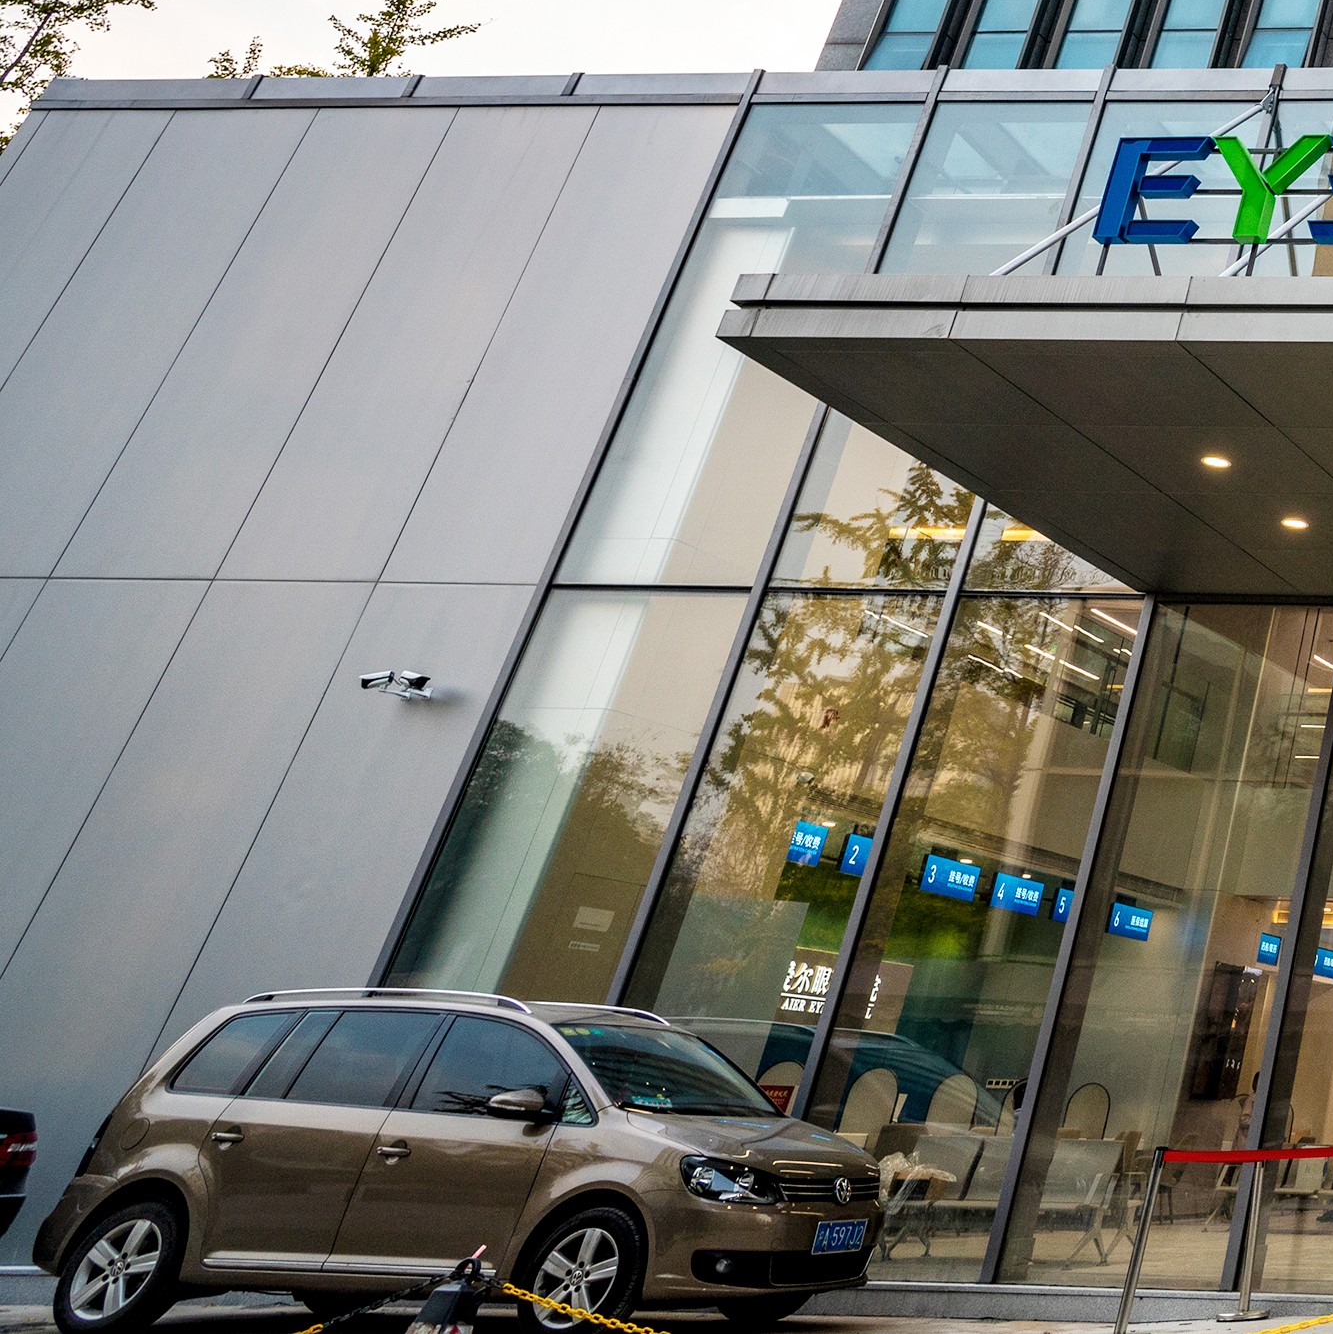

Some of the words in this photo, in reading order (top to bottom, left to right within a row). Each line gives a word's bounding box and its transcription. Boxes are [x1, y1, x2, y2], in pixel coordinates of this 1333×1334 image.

[848, 844, 860, 865] 2
[927, 864, 937, 884] 3
[997, 882, 1006, 901] 4
[1058, 896, 1067, 914] 5
[1113, 910, 1121, 927] 6
